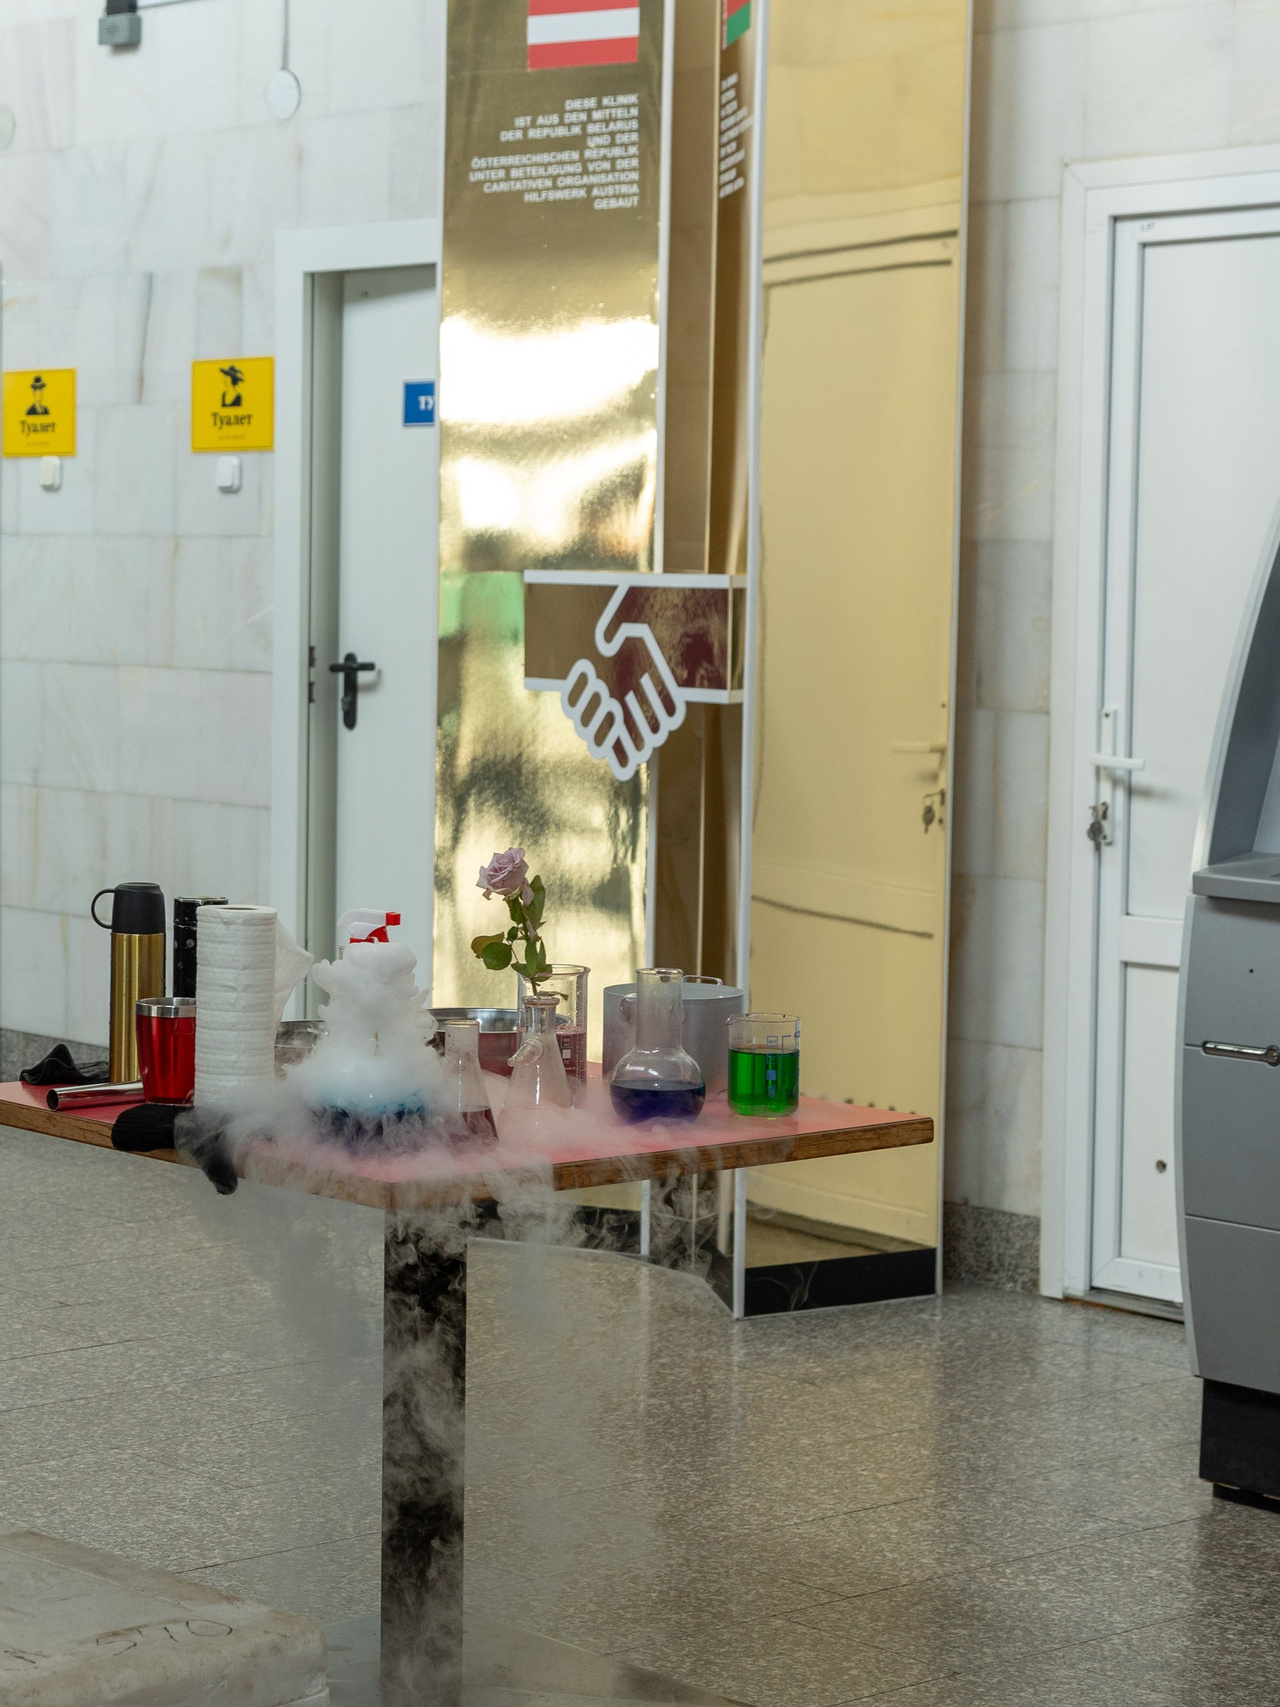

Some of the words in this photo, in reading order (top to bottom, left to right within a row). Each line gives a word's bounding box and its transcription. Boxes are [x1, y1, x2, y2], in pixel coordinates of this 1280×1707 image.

[564, 97, 598, 111] DIESE
[601, 93, 639, 107] KLINIK
[514, 116, 532, 128] IST
[536, 114, 559, 126] AUS
[564, 111, 587, 124] DEN
[591, 106, 639, 121] MITTELN
[500, 129, 523, 142] DER
[527, 124, 582, 139] REPUBLIK
[586, 119, 639, 135] BELARUS
[586, 134, 611, 147] UND
[615, 132, 639, 145] DER
[471, 150, 580, 169] ÖSTERREICHISCHEN
[584, 145, 639, 160] REPUBLIK
[469, 168, 506, 182] UNTER
[510, 162, 583, 179] BETEILIGUNG
[587, 160, 611, 172] VON
[615, 157, 640, 169] DER
[483, 178, 553, 194] CARITATIVEN
[556, 170, 639, 188] ORGANISATION
[524, 187, 587, 203] HILFSWERK
[591, 183, 640, 197] AUSTRIA
[593, 195, 640, 211] GEBAUT
[20, 419, 57, 437] Туалет
[211, 412, 253, 430] Туалет
